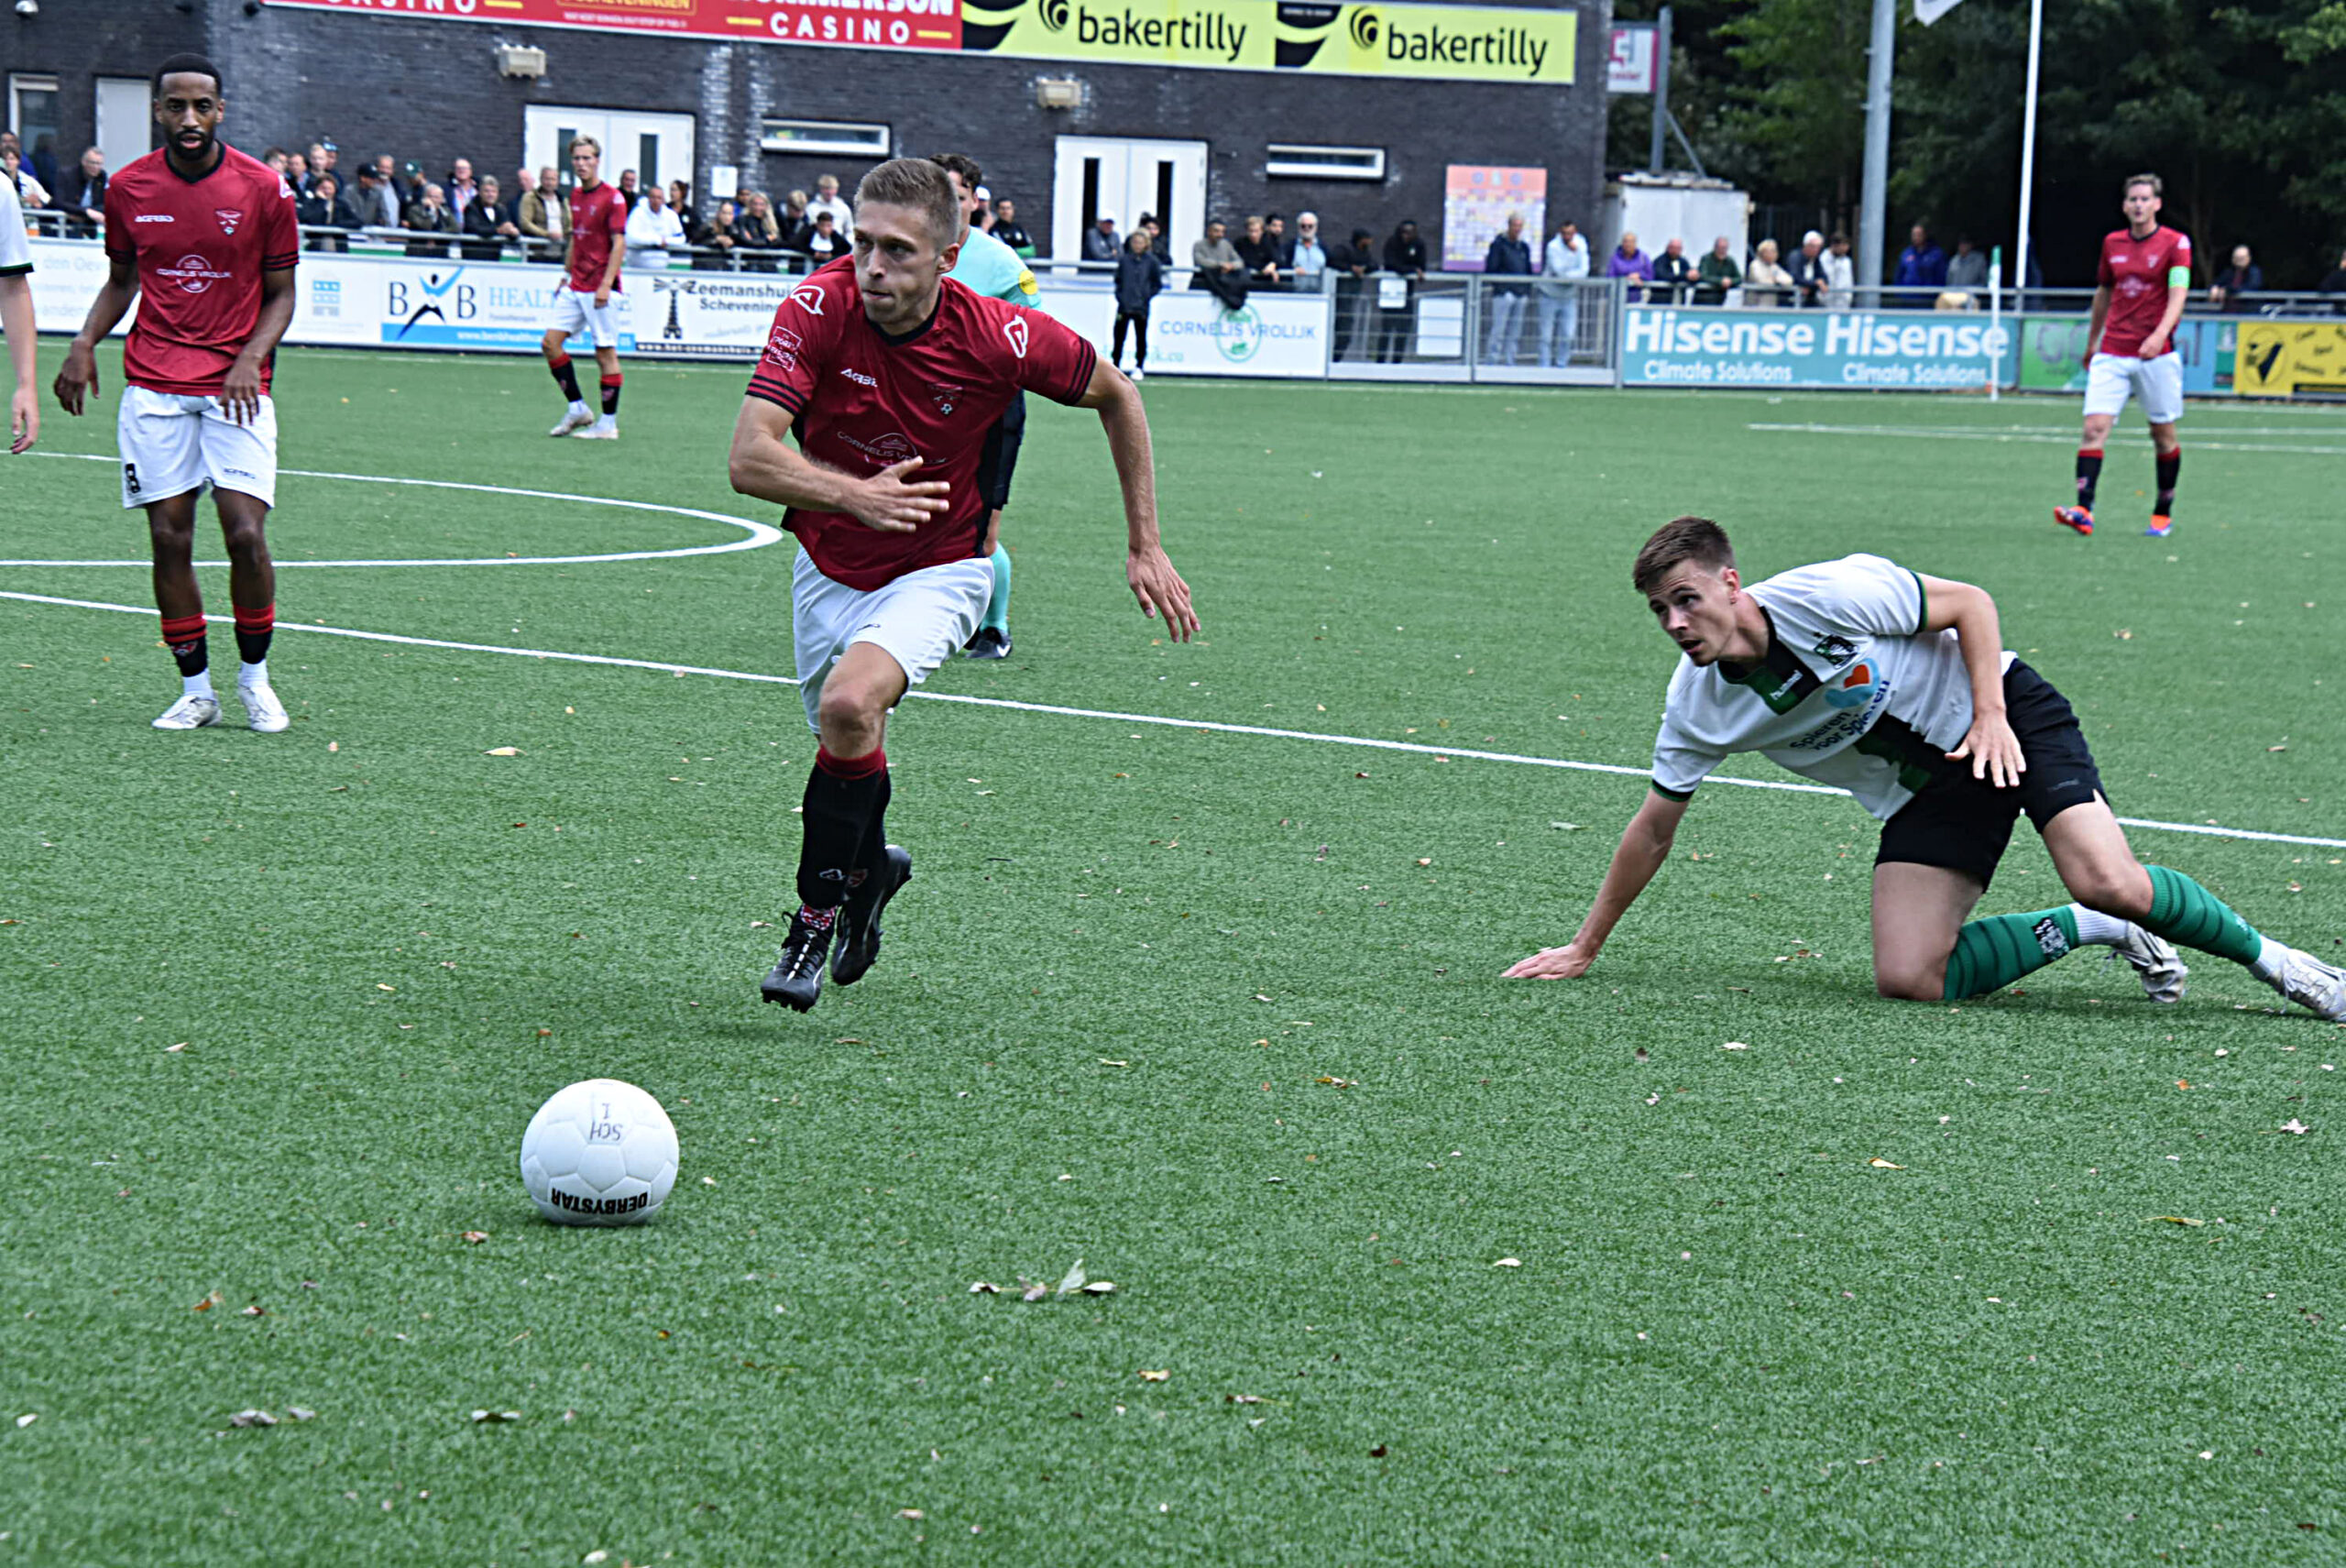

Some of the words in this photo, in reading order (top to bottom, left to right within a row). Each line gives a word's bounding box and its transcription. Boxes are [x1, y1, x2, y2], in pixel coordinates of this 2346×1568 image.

[770, 12, 910, 44] CASINO
[1078, 6, 1247, 62] bakertilly
[1386, 23, 1549, 77] bakertilly
[389, 280, 409, 316] B
[457, 283, 477, 319] B
[686, 280, 794, 299] Zeemanshui
[1159, 320, 1244, 337] CORNELIS
[1249, 323, 1317, 339] VROLIJK
[1624, 310, 1815, 356] Hisense
[1824, 314, 2009, 358] Hisense
[1643, 359, 1713, 381] Climate
[1716, 360, 1792, 382] Solutions
[1842, 362, 1909, 383] Climate
[1913, 363, 1988, 385] Solutions
[550, 1188, 649, 1215] DERBYSTAR
